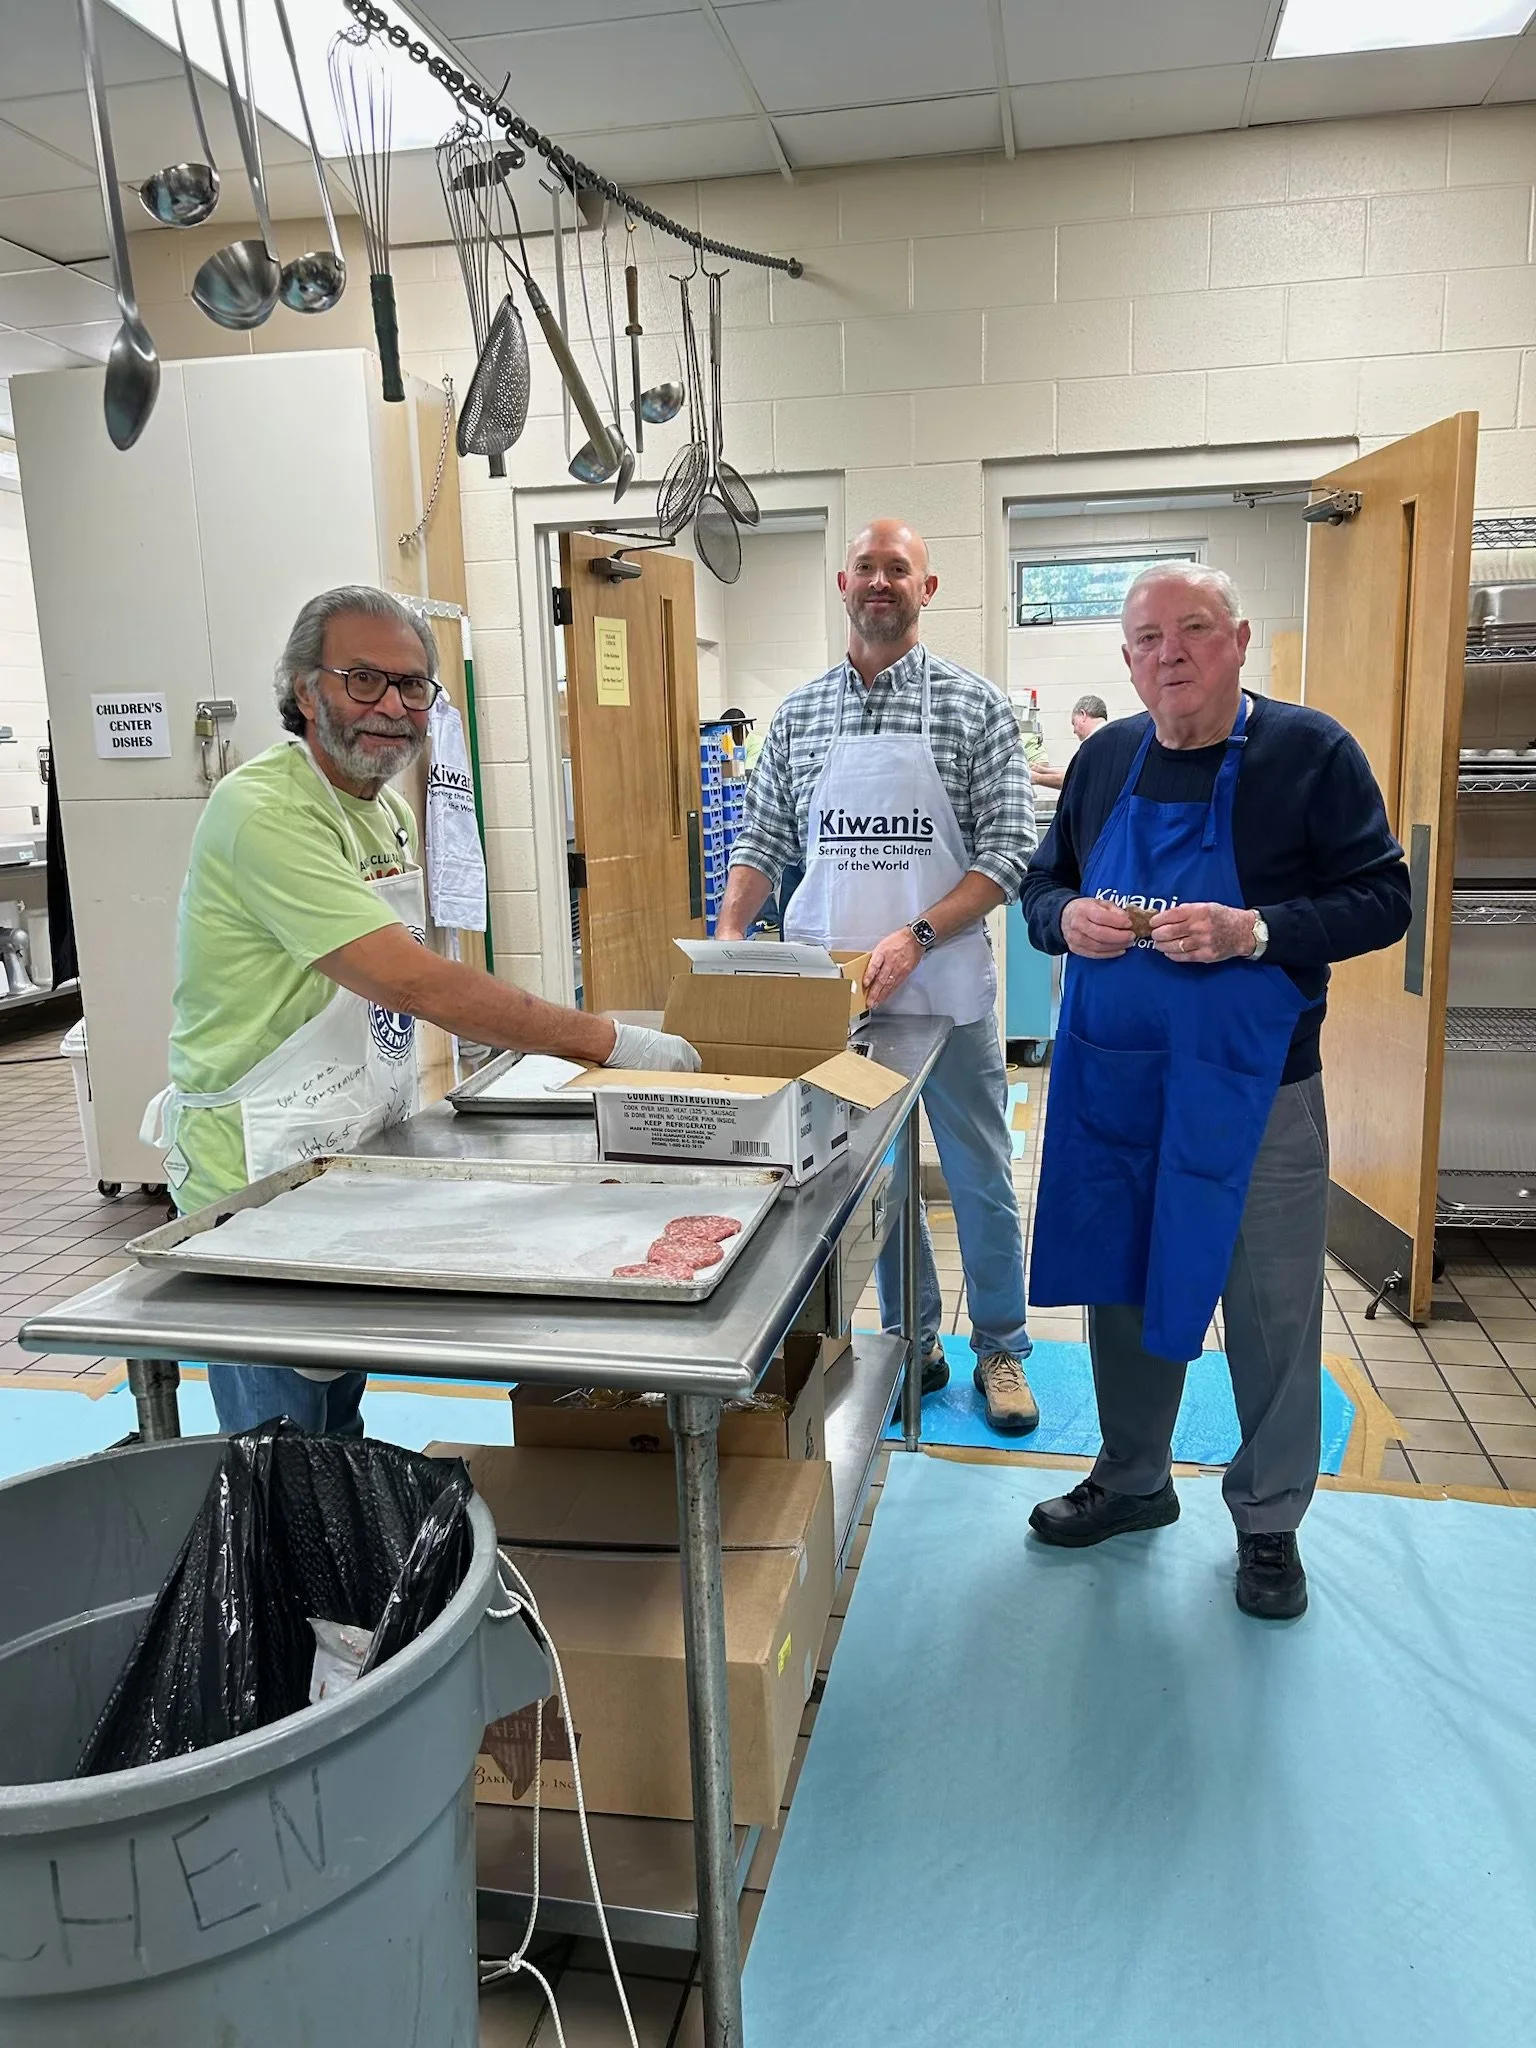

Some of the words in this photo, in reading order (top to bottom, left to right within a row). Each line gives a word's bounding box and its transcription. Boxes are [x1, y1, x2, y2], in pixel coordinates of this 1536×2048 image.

[96, 702, 162, 715] CHILDREN'S
[109, 719, 152, 731] CENTER
[112, 735, 153, 748] DISHES
[819, 808, 934, 836] Kiwanis
[818, 845, 857, 857] Serving
[860, 845, 879, 855] the
[883, 845, 931, 856] Children
[837, 861, 848, 871] of
[851, 861, 870, 871] the
[872, 860, 909, 871] World
[1095, 888, 1178, 914] Kiwani
[665, 1121, 717, 1130] REFRIGERATED
